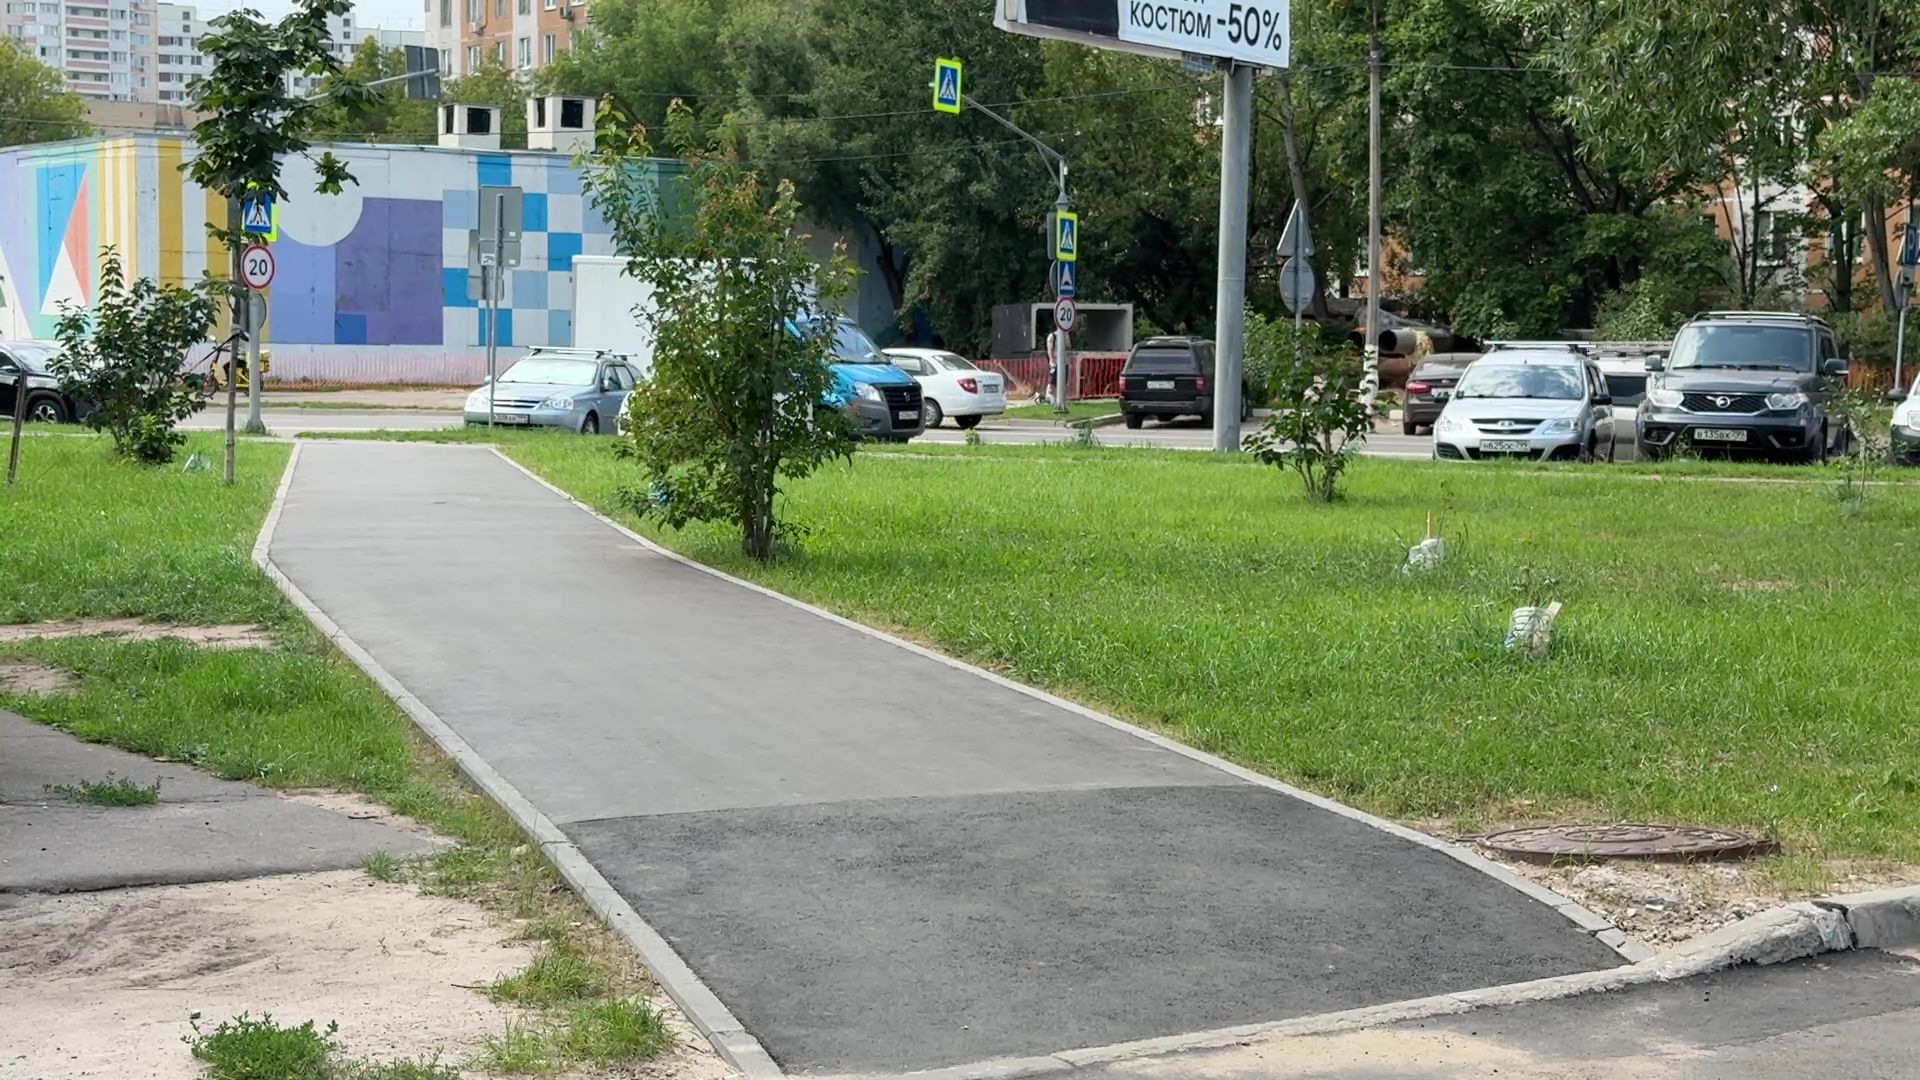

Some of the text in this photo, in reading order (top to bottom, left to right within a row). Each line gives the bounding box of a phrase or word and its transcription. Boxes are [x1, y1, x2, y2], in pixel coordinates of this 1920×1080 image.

[1130, 0, 1282, 51] КОСТЮМ -50%
[249, 258, 268, 276] 20
[1060, 307, 1072, 321] 20
